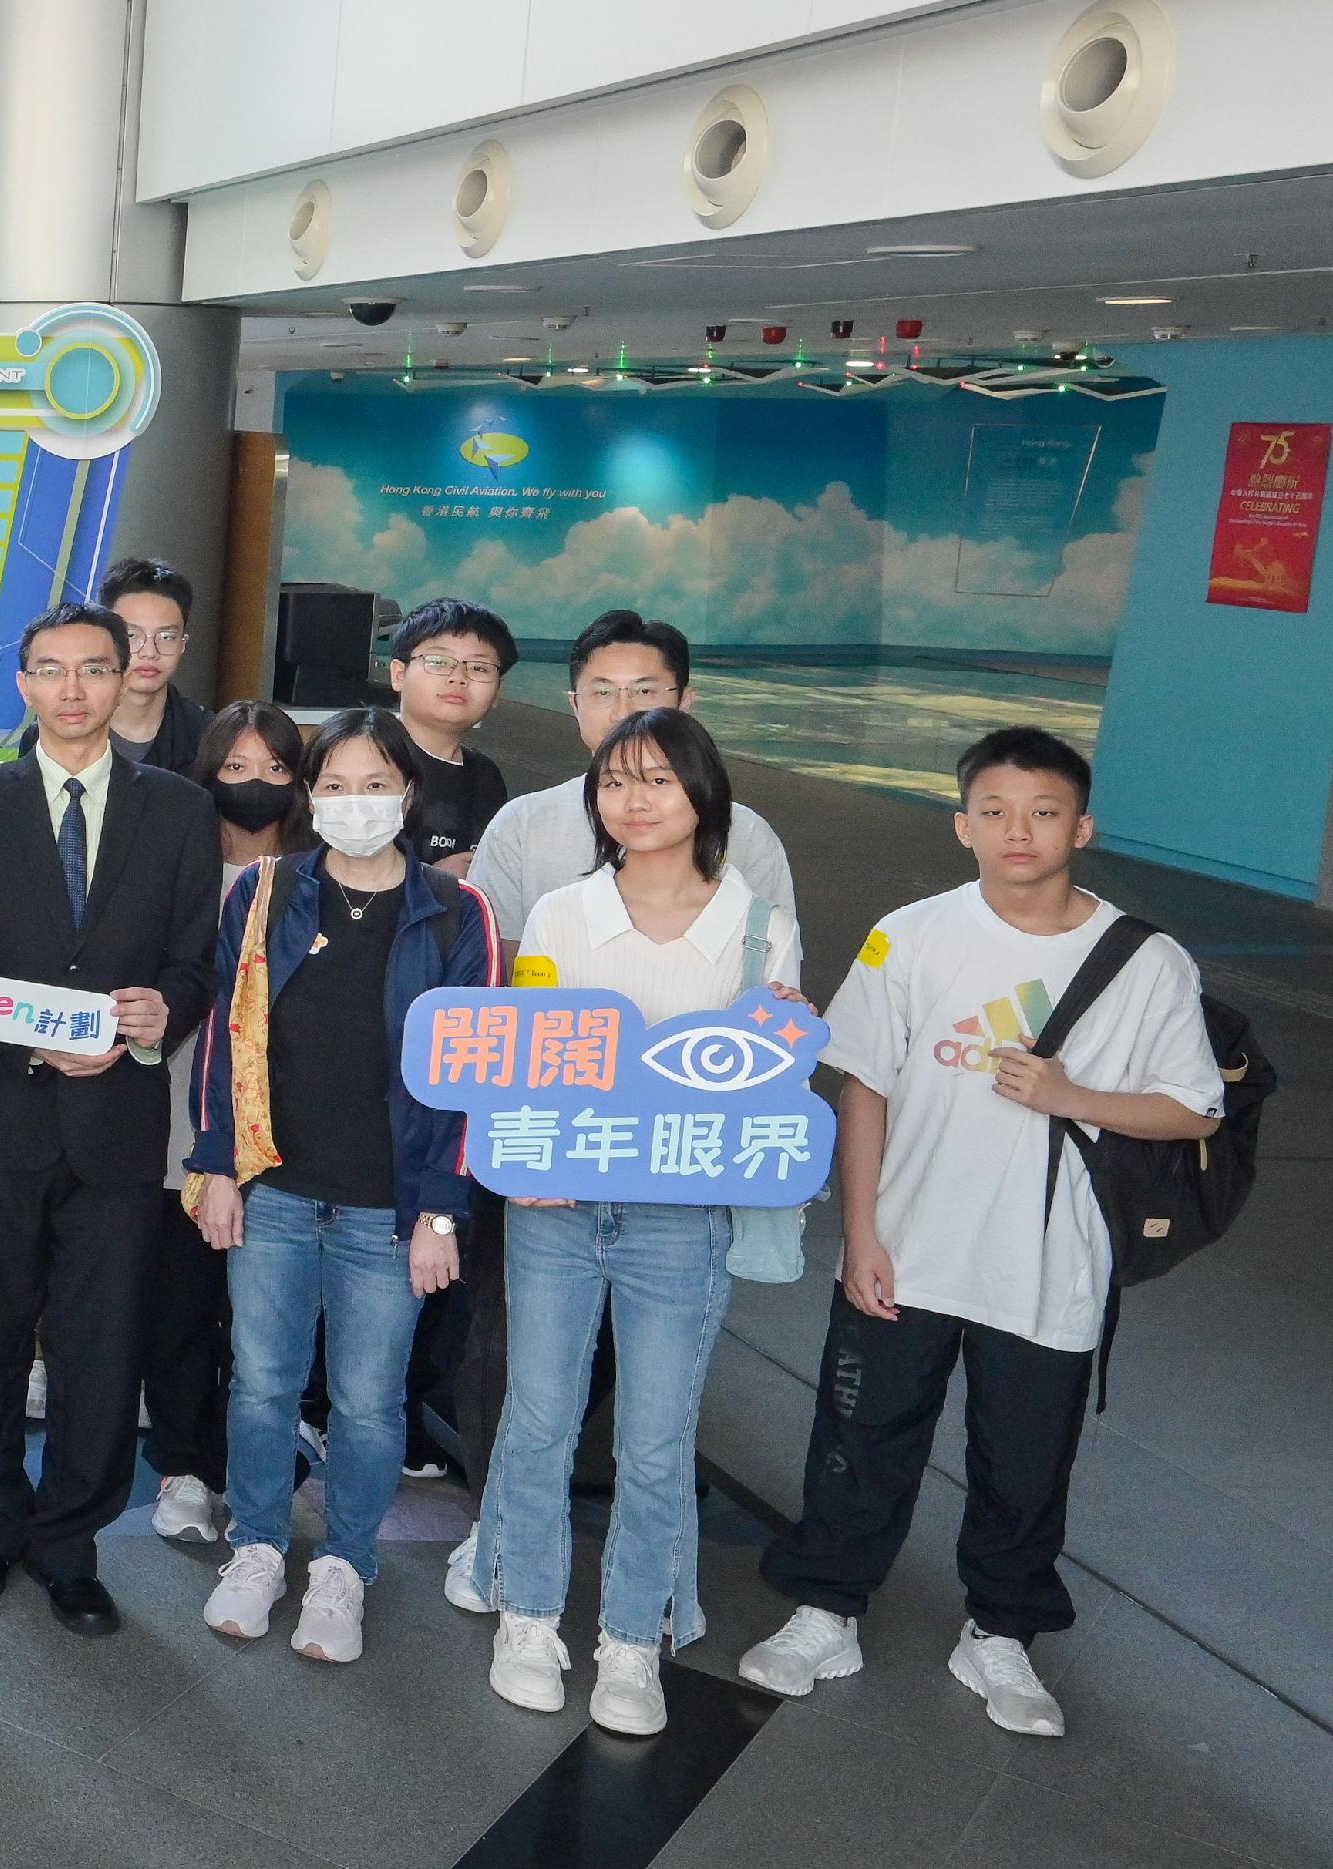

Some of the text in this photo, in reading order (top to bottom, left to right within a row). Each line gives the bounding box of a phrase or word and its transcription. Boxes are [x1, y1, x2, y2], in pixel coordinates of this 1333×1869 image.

[412, 485, 442, 497] Kong
[445, 486, 469, 496] Civil
[584, 490, 607, 500] you
[428, 1005, 621, 1092] 開闊
[487, 1104, 811, 1181] 青年眼界
